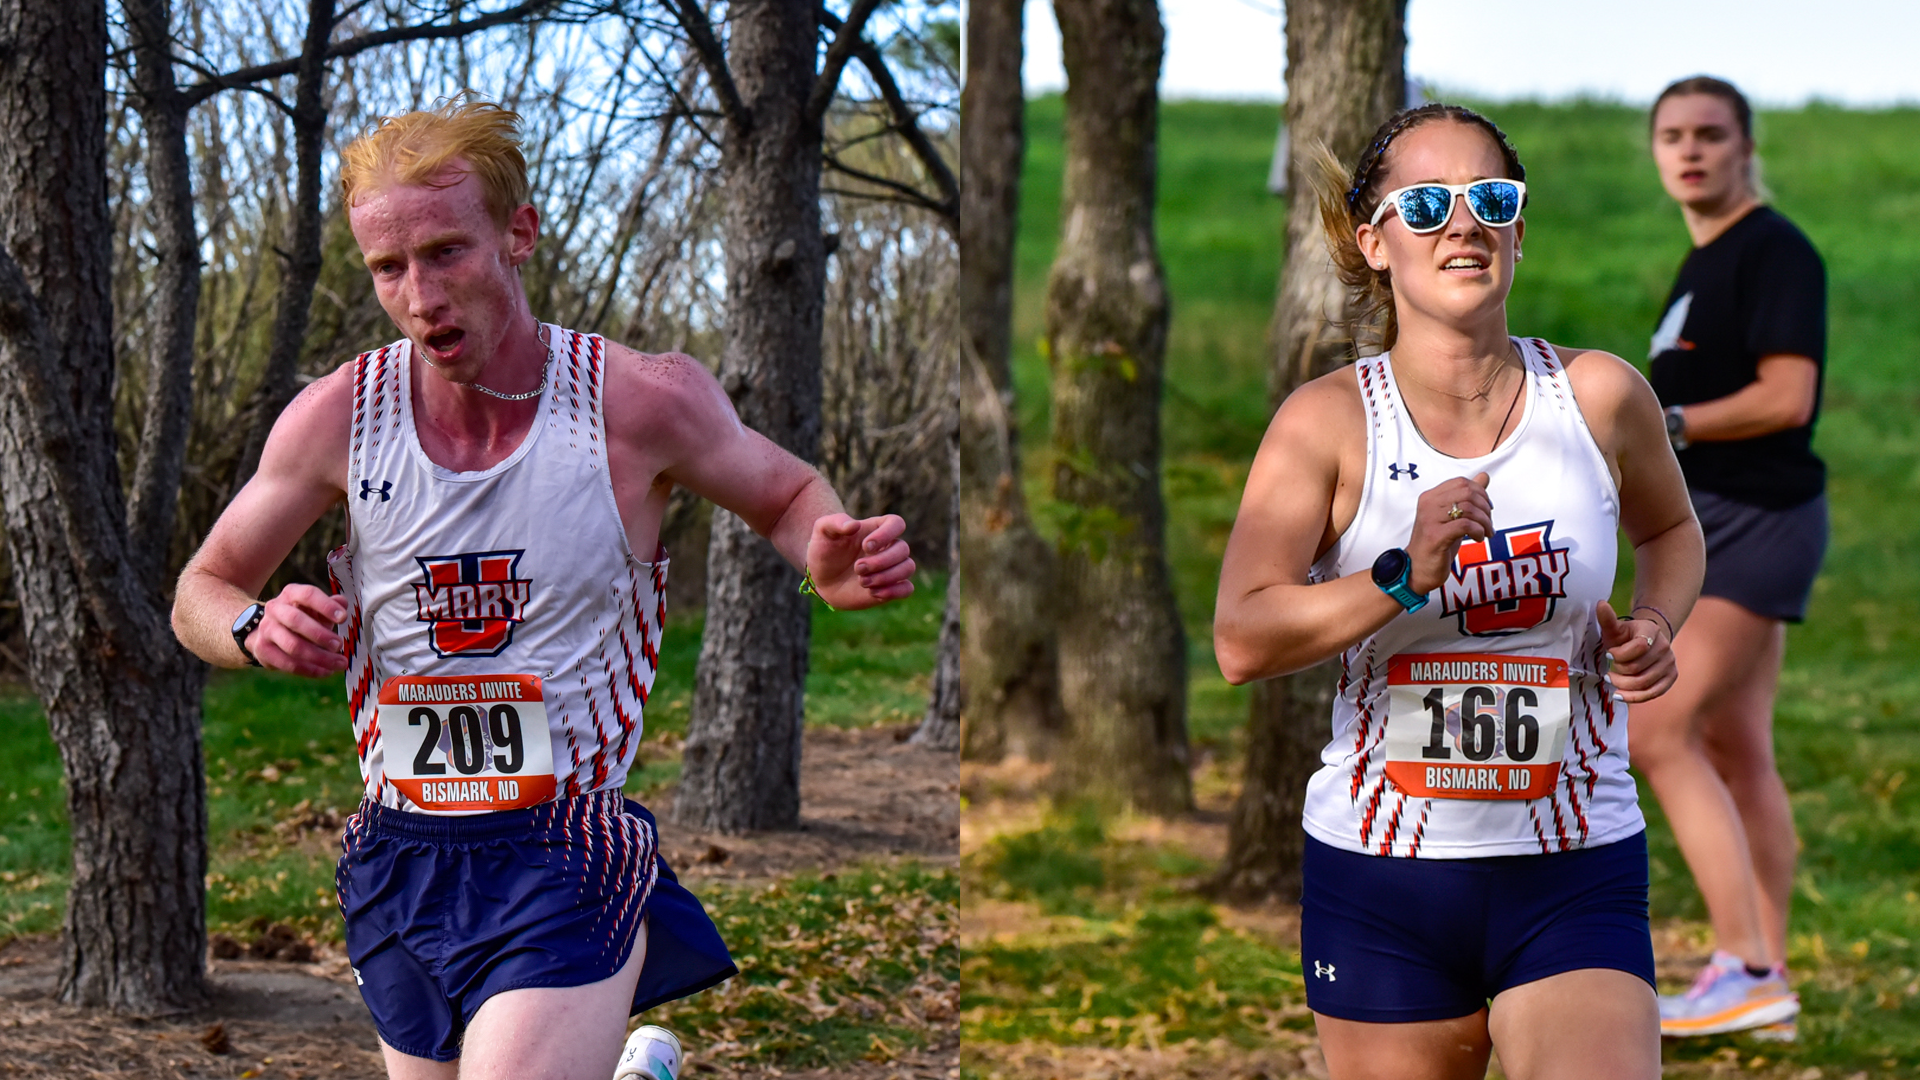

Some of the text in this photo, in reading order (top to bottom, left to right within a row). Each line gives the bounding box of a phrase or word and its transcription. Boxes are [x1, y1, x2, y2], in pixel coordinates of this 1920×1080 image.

[1442, 548, 1569, 617] MARY
[412, 579, 532, 622] MARY
[1410, 661, 1548, 684] MARAUDERS INVITE
[398, 681, 523, 702] MARAUDERS INVITE
[408, 704, 525, 775] 209
[1422, 686, 1540, 762] 166
[422, 780, 520, 803] BISMARK, ND
[1425, 766, 1532, 792] BISMARK, ND
